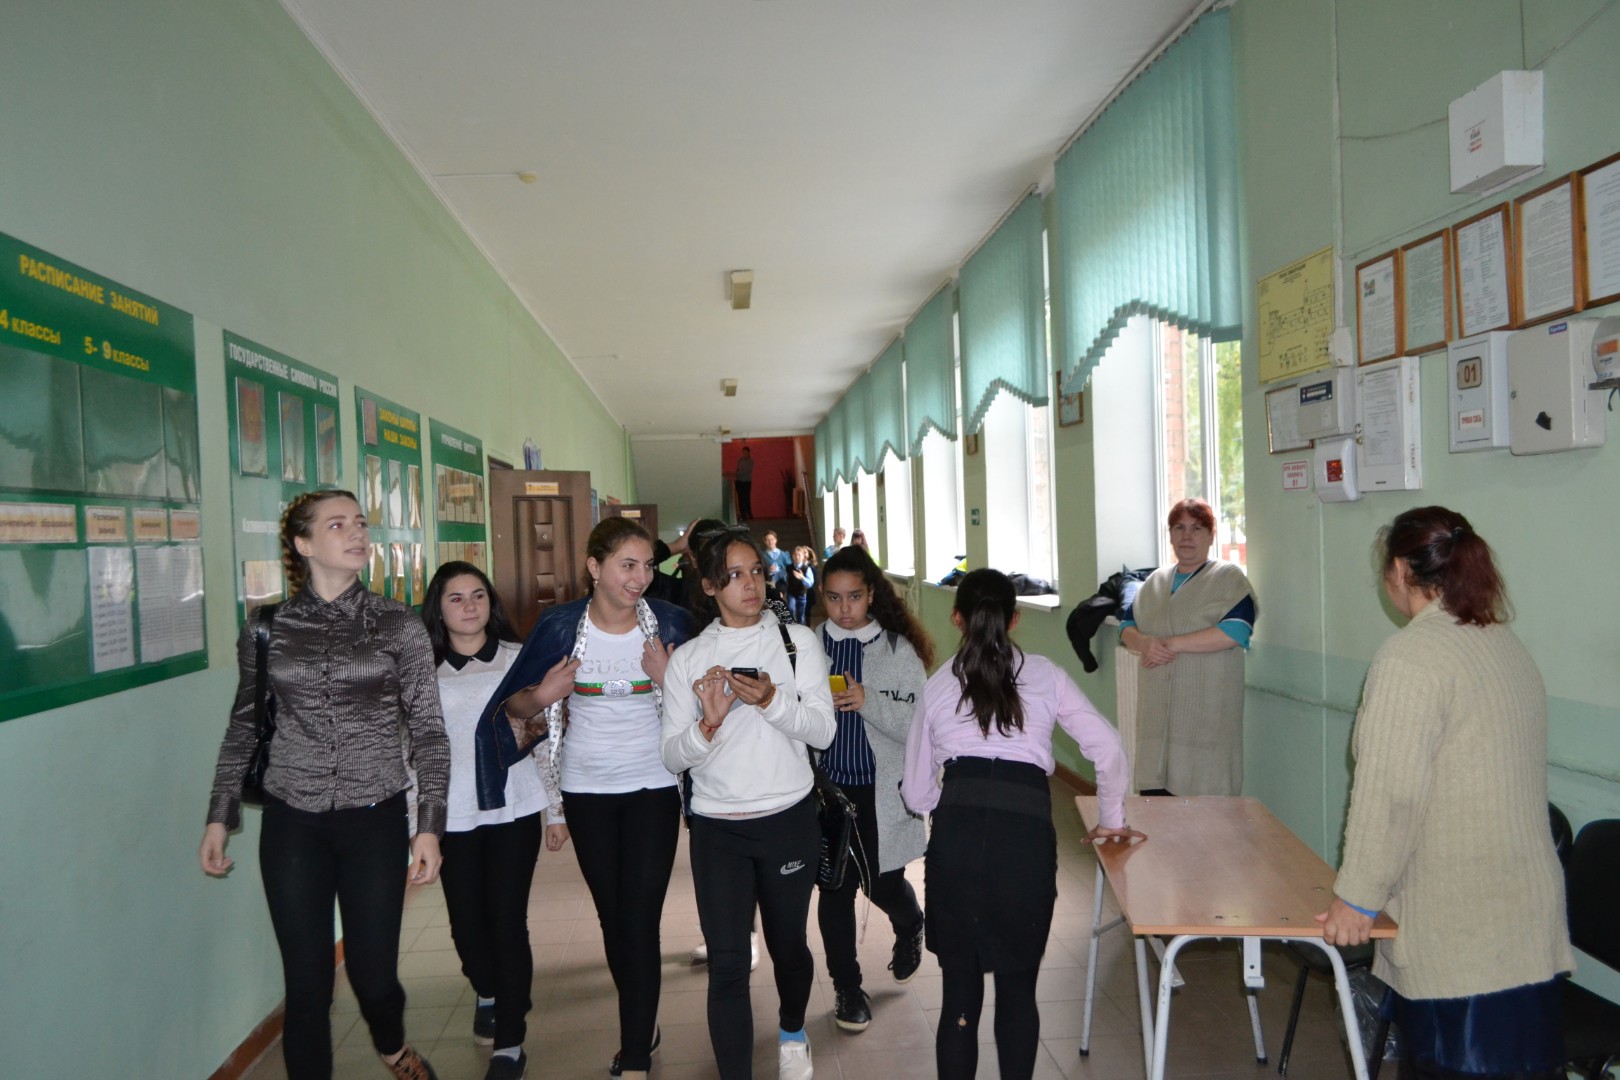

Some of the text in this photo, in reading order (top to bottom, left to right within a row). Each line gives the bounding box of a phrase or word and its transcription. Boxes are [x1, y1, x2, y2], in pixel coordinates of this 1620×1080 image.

[19, 254, 159, 326] РАСПИСАНИЕ ЗАНЯТИЙ
[12, 317, 61, 345] классы
[112, 349, 149, 372] классы
[229, 342, 288, 380] ГОСУДАРСТВЕННЫЕ
[1463, 363, 1477, 384] 01
[579, 656, 642, 675] GUCC
